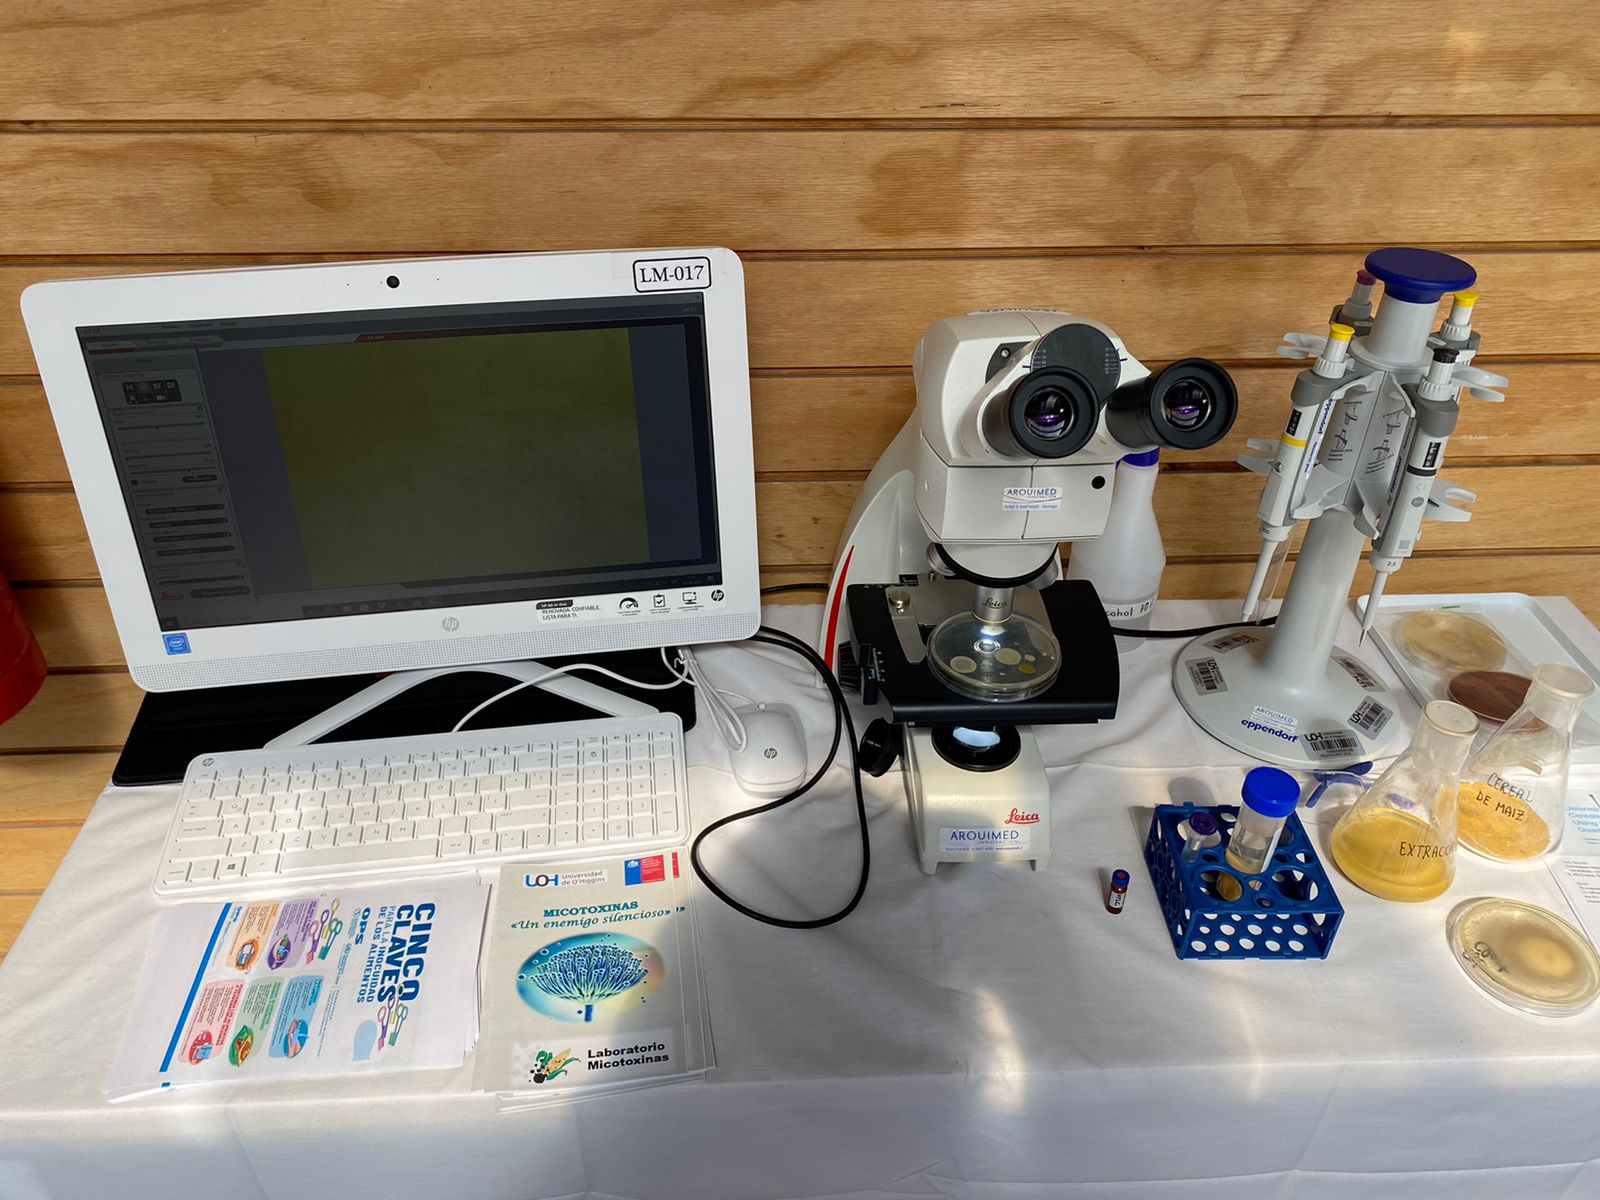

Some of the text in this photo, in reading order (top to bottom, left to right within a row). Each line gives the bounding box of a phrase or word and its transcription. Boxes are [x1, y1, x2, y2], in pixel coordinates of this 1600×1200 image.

[640, 265, 704, 283] LM-017
[1241, 719, 1300, 743] eppendorf
[1487, 772, 1533, 803] CEREAL
[1004, 808, 1040, 824] Leica
[1476, 789, 1526, 822] DE MAIZ
[561, 870, 603, 880] Universidad
[387, 905, 397, 930] PARA
[543, 901, 639, 918] MICOTOXINAS
[354, 907, 371, 945] OPS
[543, 915, 599, 929] enemigo
[356, 906, 388, 1003] DE LOS ALIMENTOS
[377, 904, 415, 1003] CLAVES
[398, 902, 436, 1001] CINCO
[366, 946, 387, 1003] INOCUIDAD
[587, 1042, 665, 1058] Laboratorio
[587, 1054, 670, 1070] Micotoxinas
